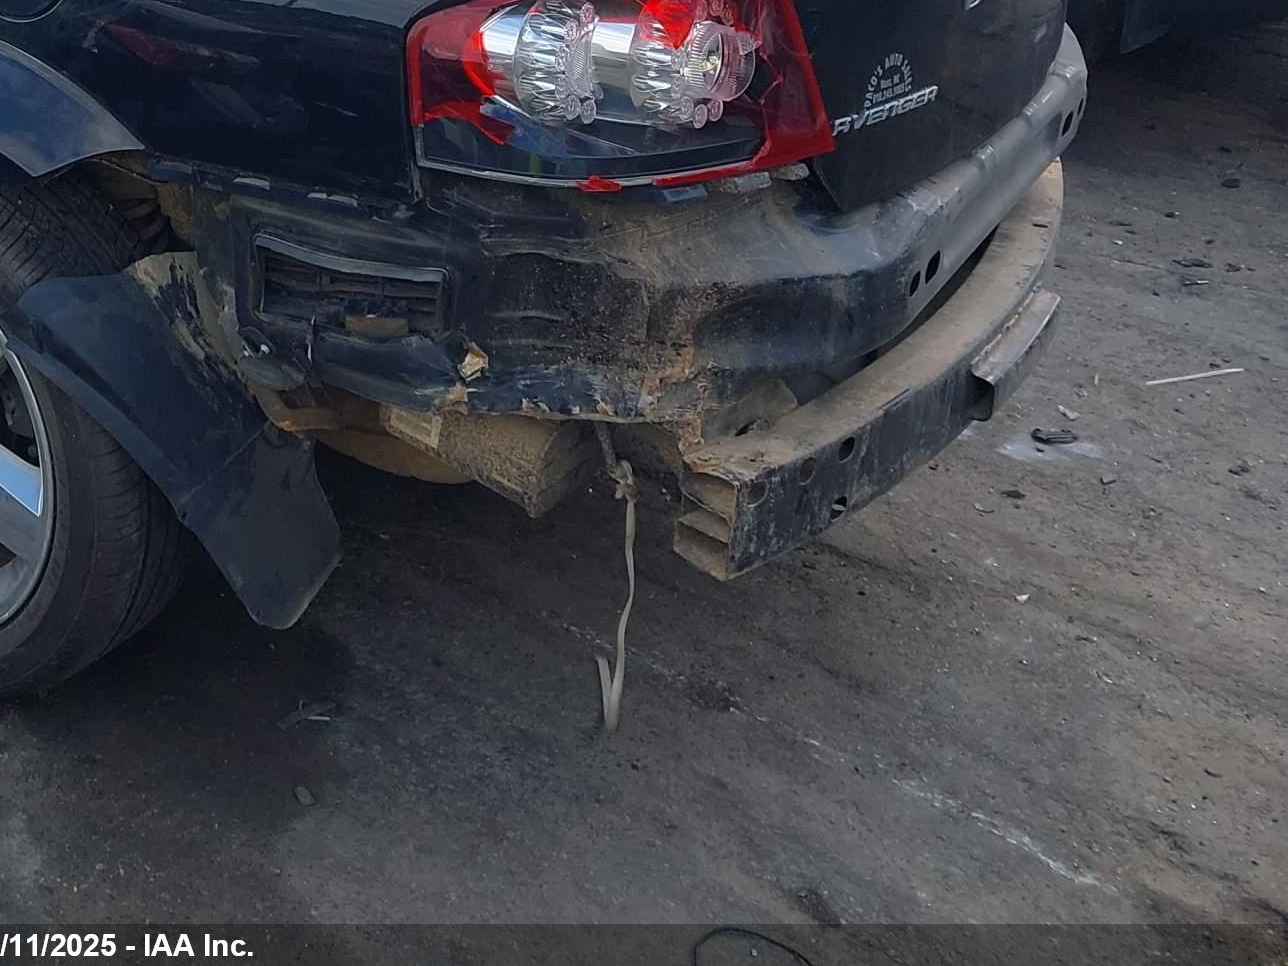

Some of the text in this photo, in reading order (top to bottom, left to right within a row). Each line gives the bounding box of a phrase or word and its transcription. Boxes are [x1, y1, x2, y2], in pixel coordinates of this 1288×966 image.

[864, 65, 884, 108] PACO'S
[884, 53, 903, 70] AUTO
[832, 85, 939, 137] AVENGER
